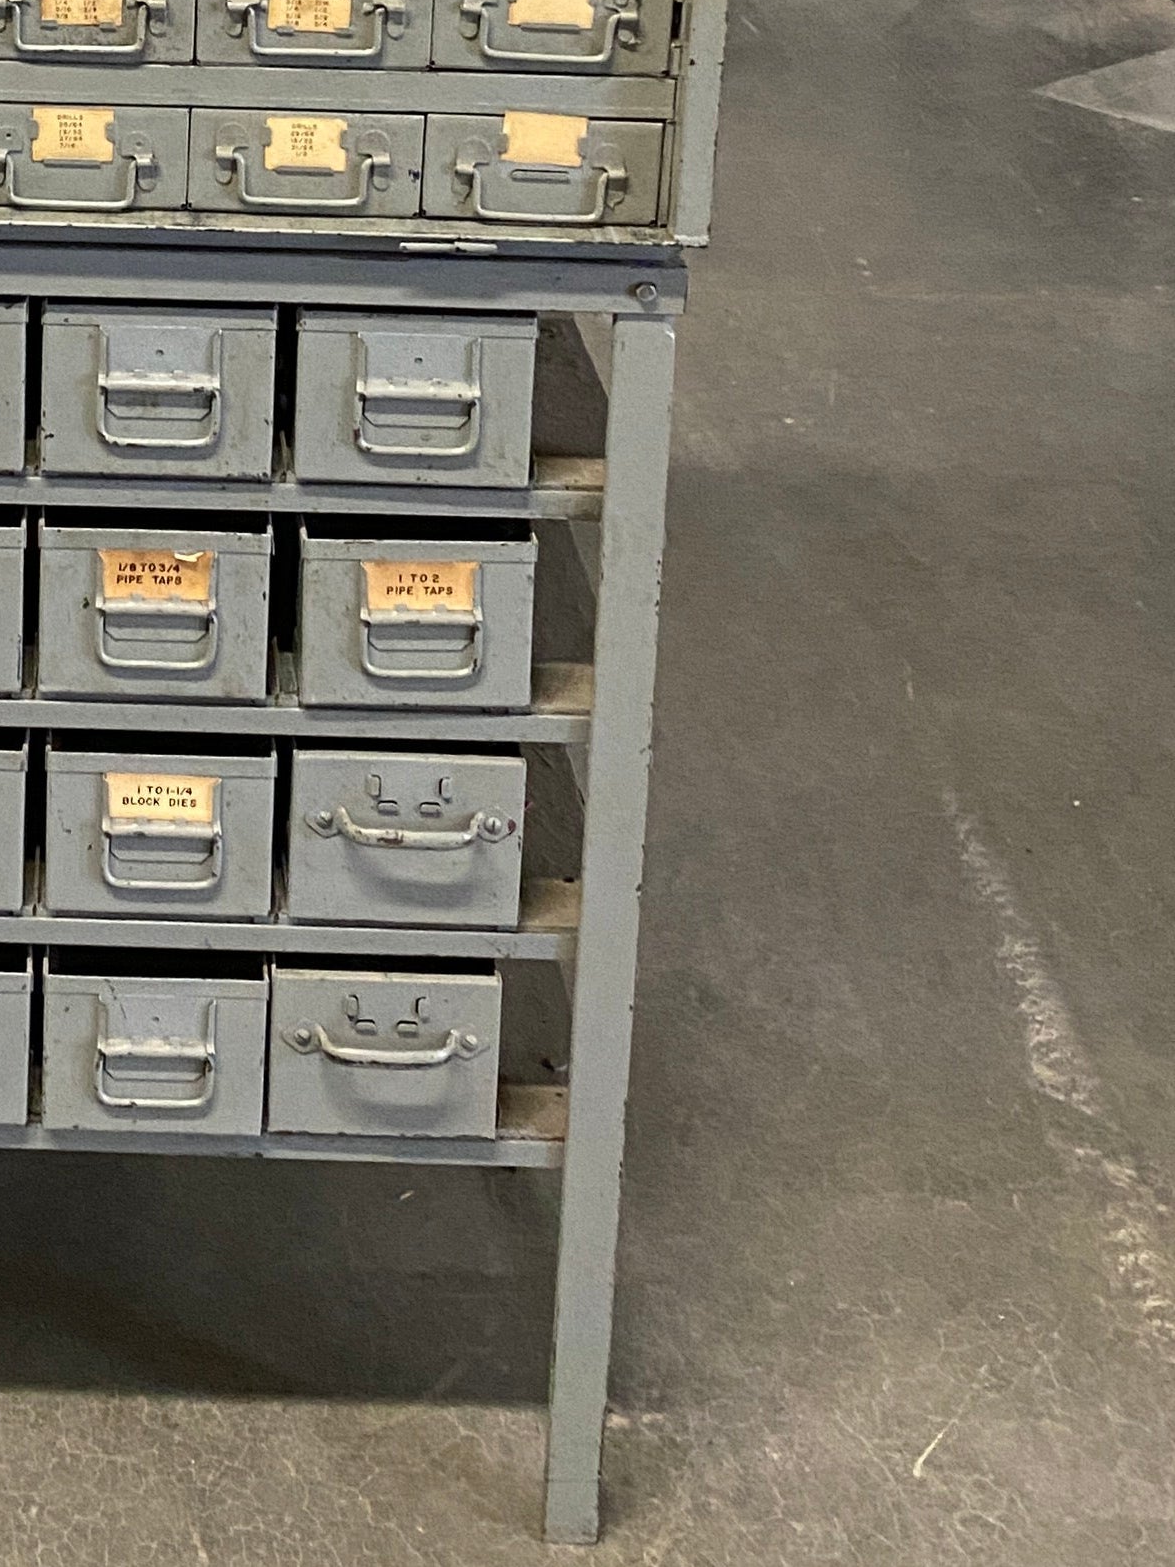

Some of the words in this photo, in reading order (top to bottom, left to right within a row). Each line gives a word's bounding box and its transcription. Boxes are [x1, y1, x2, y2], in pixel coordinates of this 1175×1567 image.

[118, 563, 137, 573] 1/8
[140, 563, 158, 573] TO
[158, 563, 180, 574] 3/4
[117, 575, 143, 585] PIPE
[152, 575, 182, 585] TAPS
[410, 574, 428, 583] TO
[432, 574, 440, 583] 2
[386, 587, 414, 596] PIPE
[424, 587, 453, 596] TAPS
[147, 786, 164, 795] TO
[166, 786, 193, 796] 1-1/4
[122, 797, 160, 806] BLOCK
[169, 797, 197, 807] DIES
